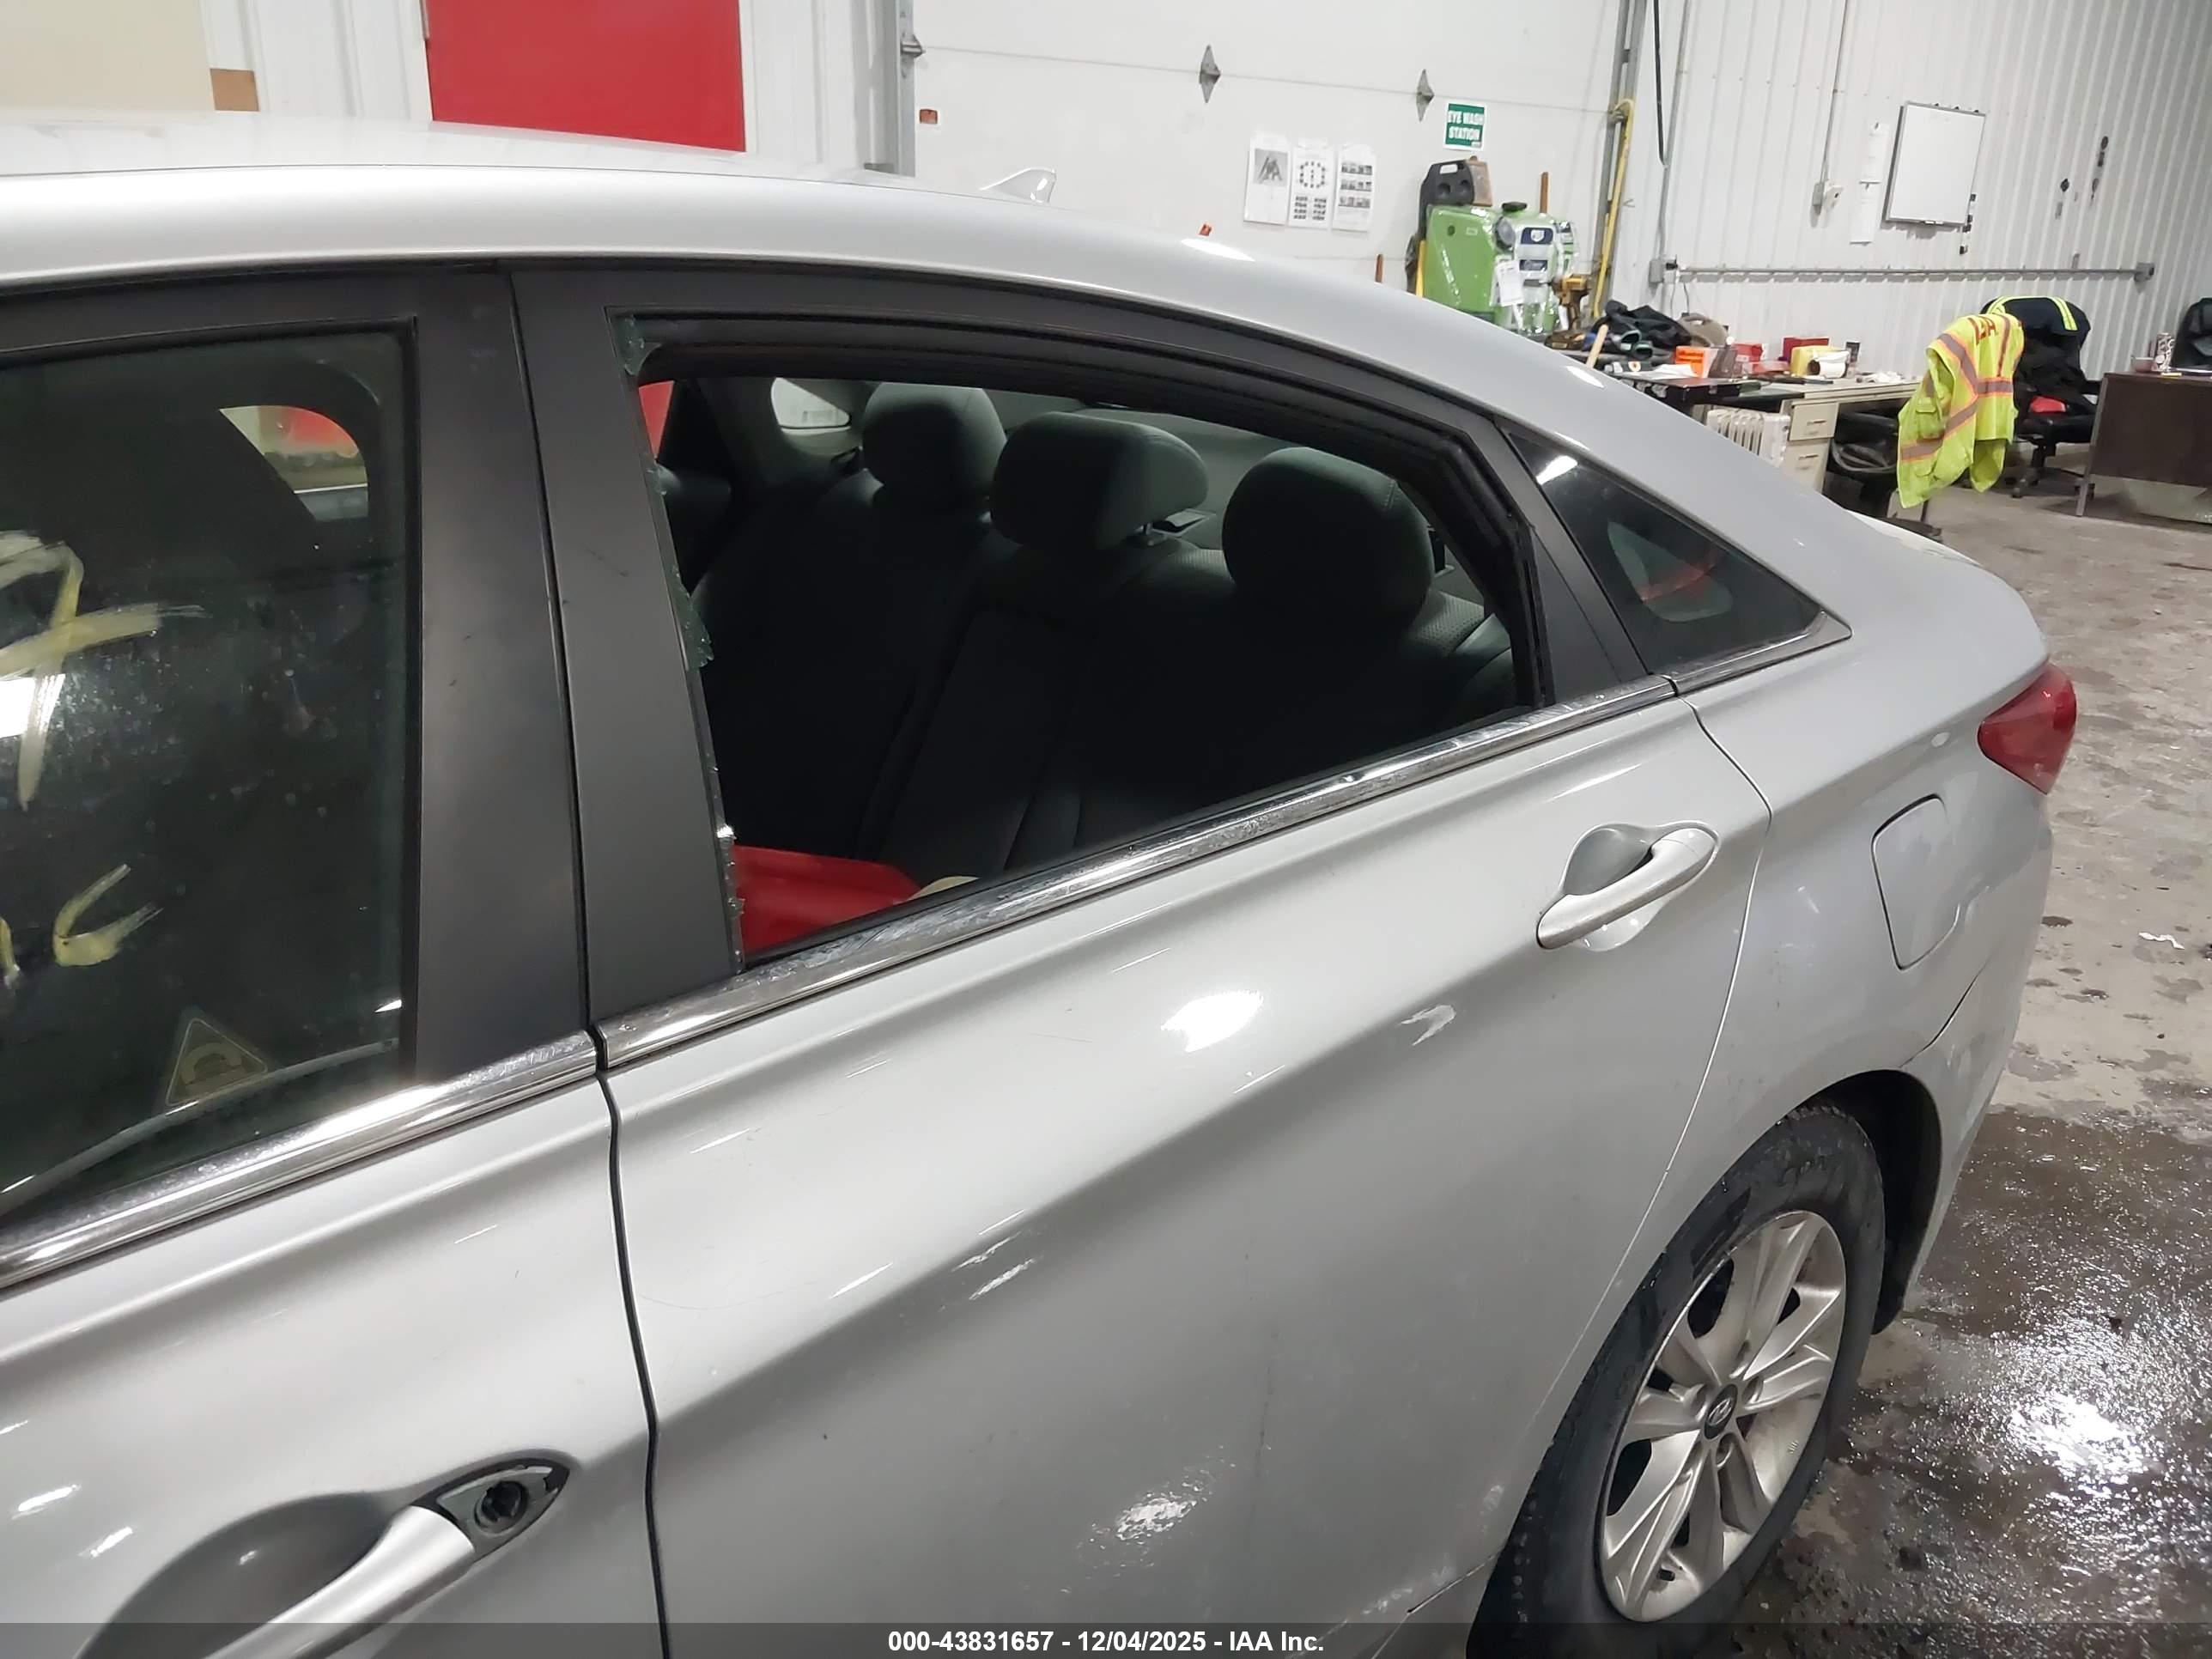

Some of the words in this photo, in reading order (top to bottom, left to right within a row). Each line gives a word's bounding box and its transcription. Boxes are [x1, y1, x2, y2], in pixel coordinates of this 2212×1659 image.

[1448, 110, 1462, 124] EYE
[1462, 112, 1485, 125] WASH
[1449, 126, 1480, 140] STATION
